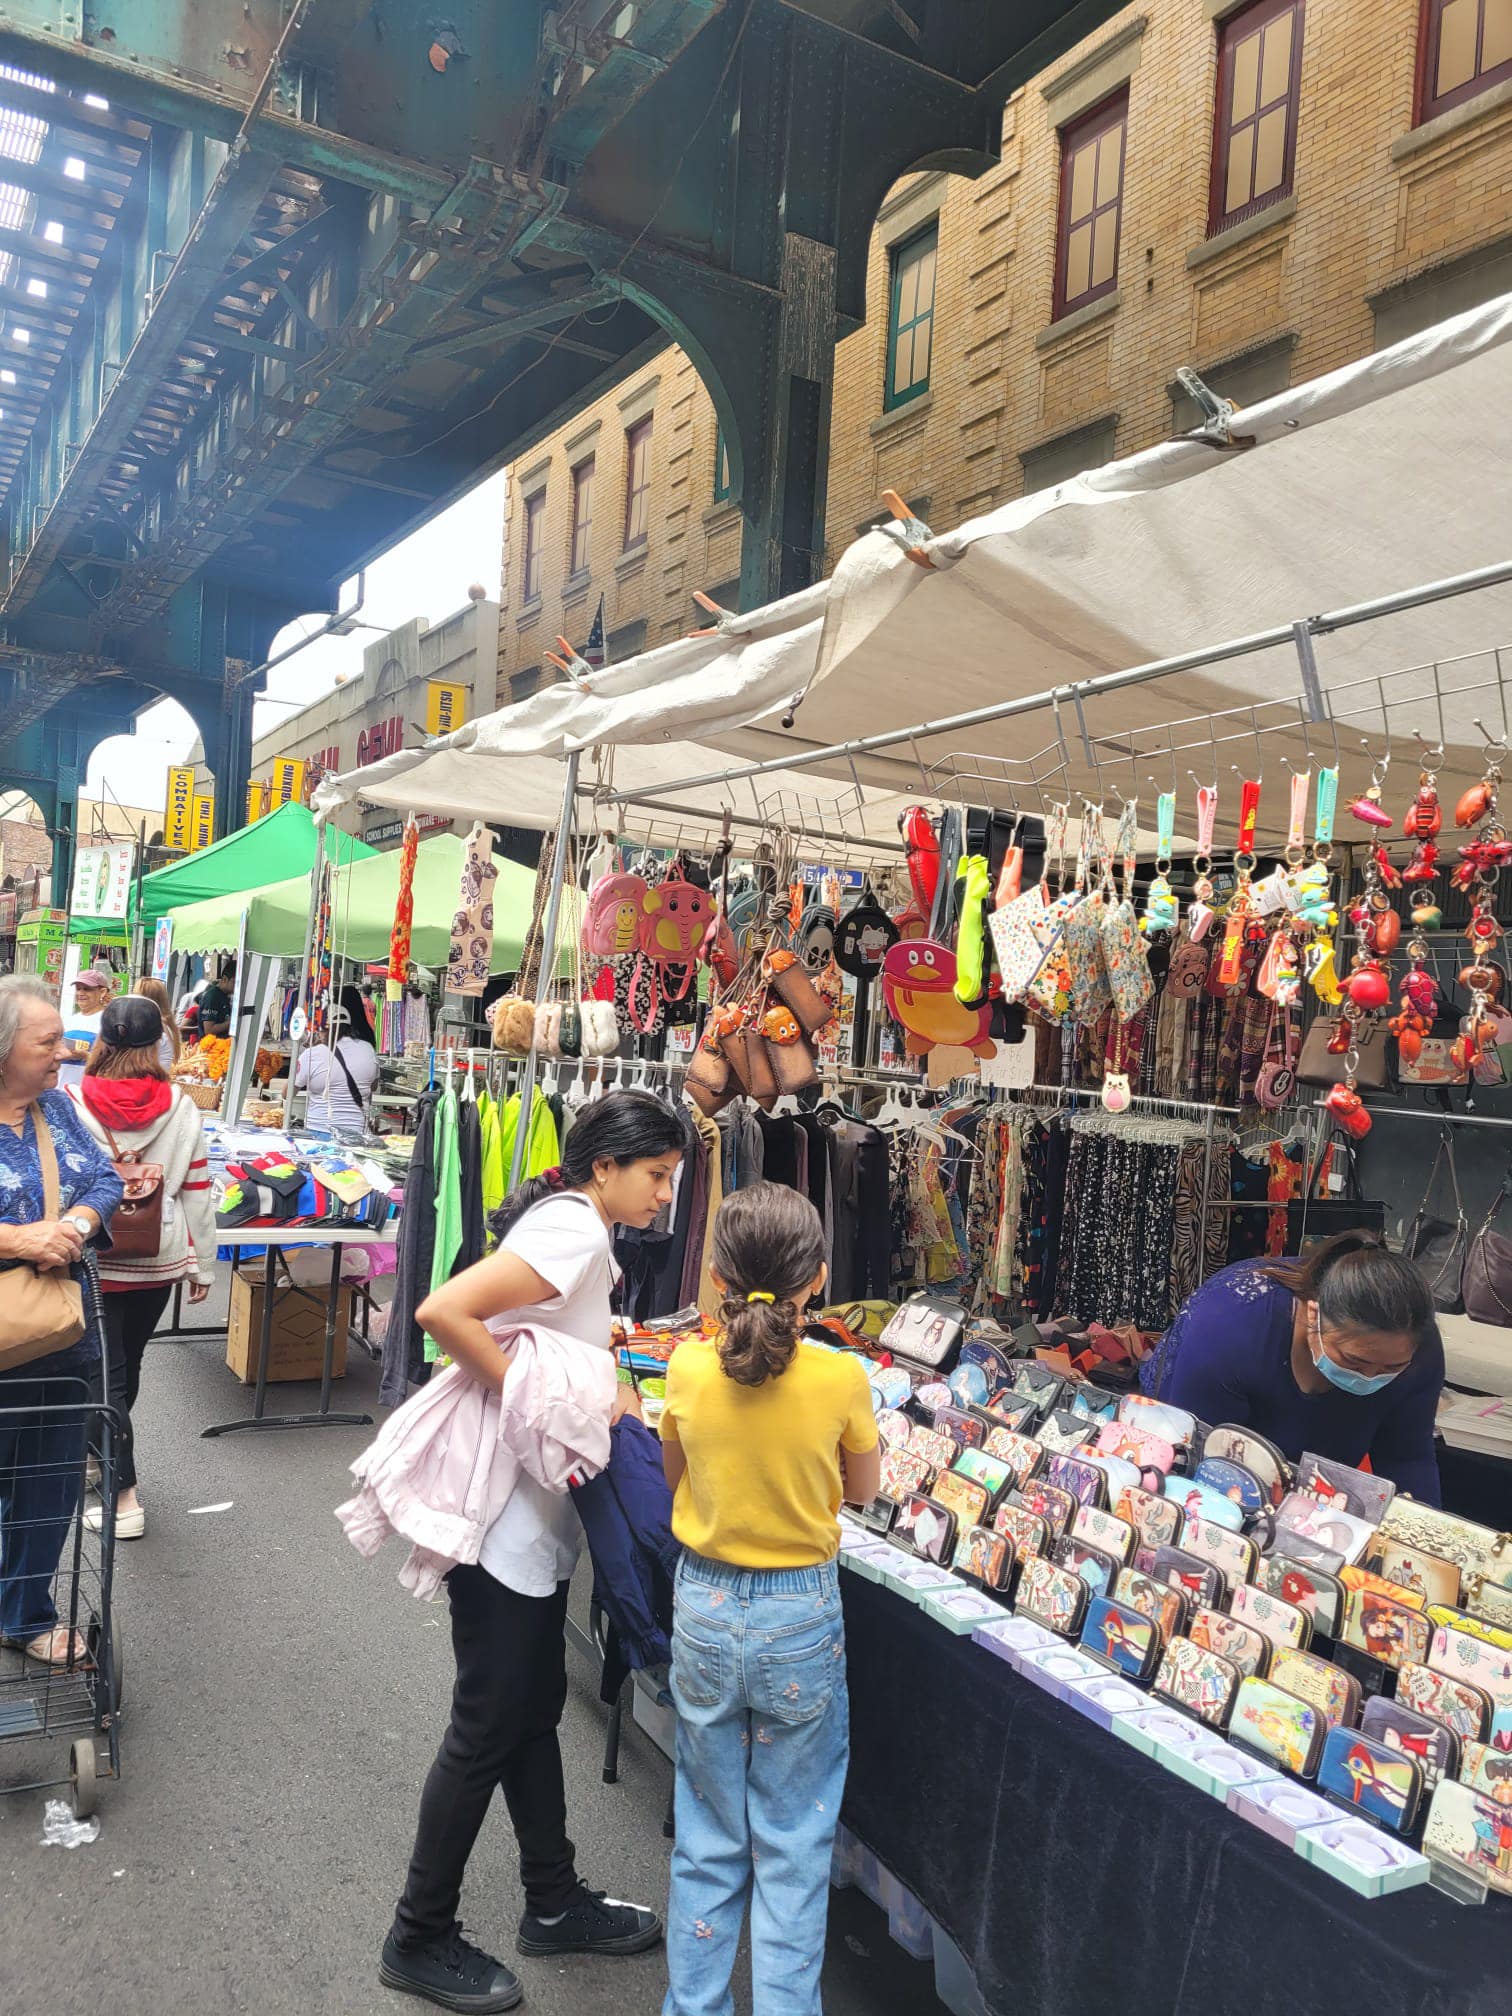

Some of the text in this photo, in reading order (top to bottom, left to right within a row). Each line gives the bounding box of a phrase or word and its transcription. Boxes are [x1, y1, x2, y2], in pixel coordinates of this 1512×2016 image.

[438, 691, 453, 728] JIU-JITSU
[173, 773, 188, 846] COMBATIVES
[198, 800, 211, 847] MUAY THAI
[382, 822, 402, 838] SUPPLIES
